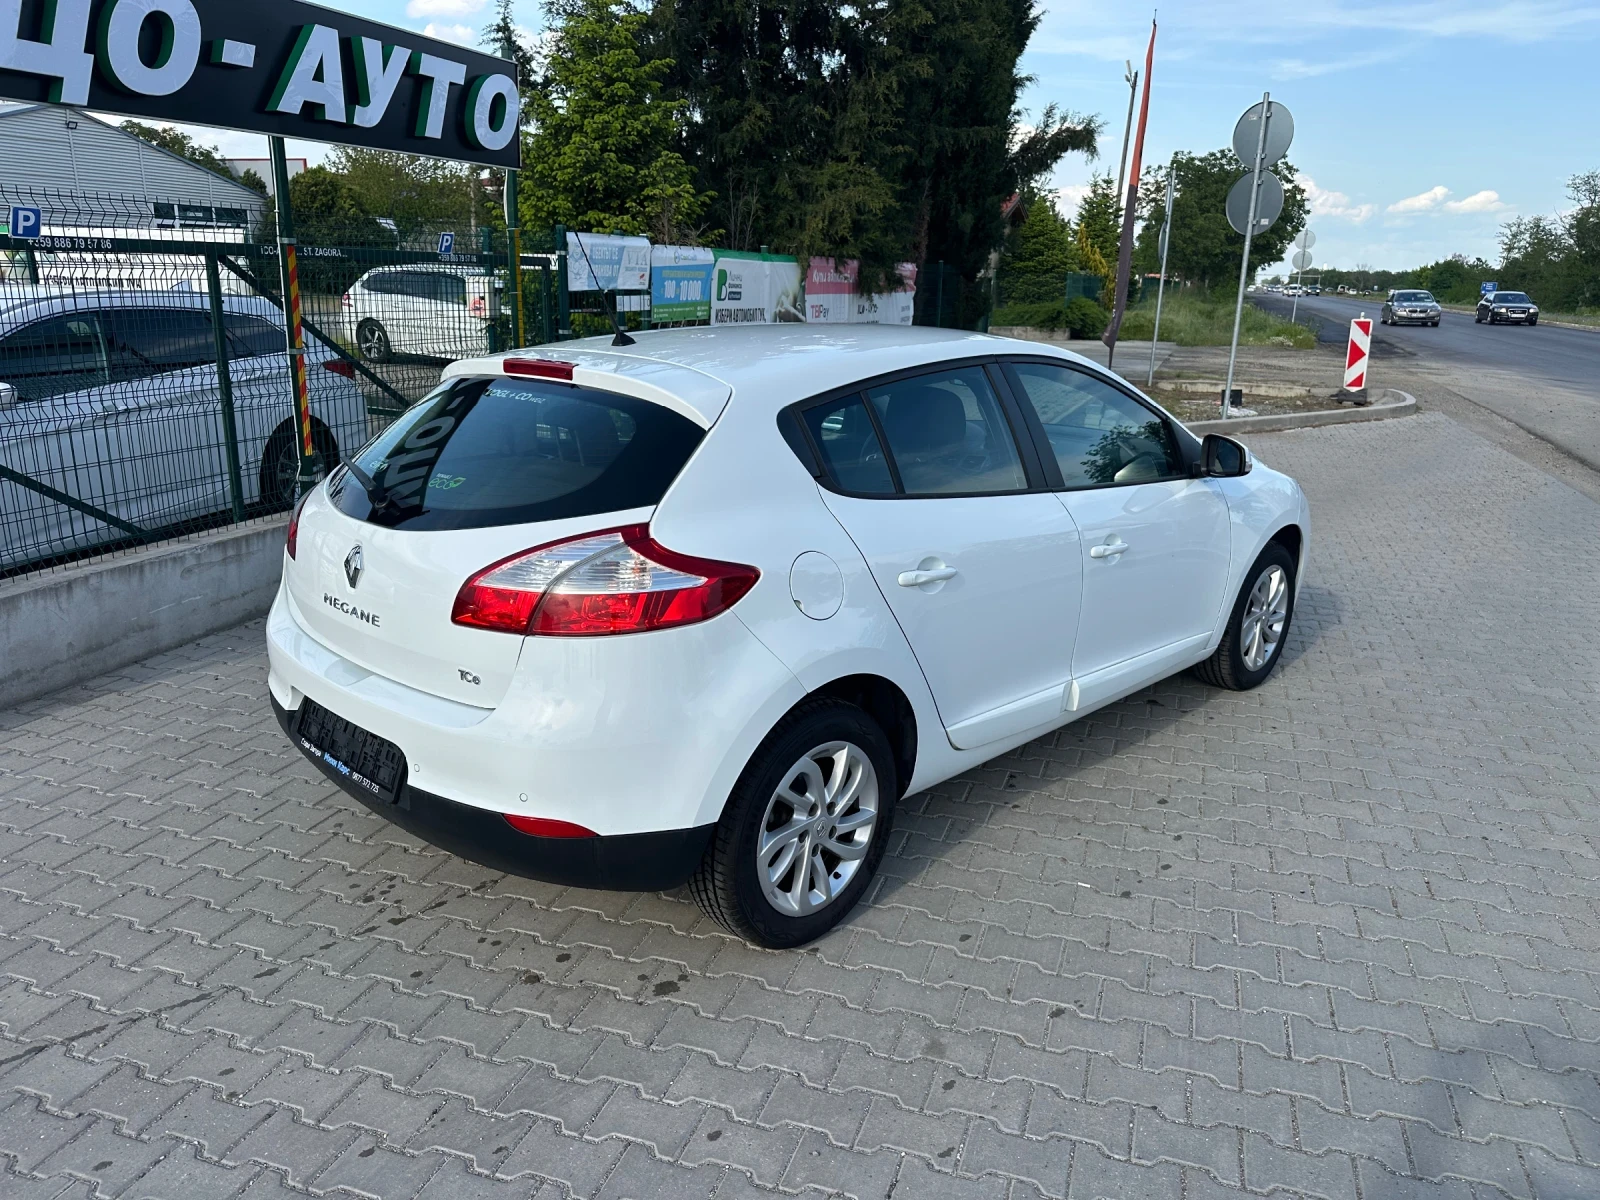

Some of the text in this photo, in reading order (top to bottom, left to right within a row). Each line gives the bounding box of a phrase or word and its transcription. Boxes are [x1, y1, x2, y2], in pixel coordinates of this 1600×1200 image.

[17, 210, 36, 235] P
[54, 237, 72, 248] 886
[73, 238, 85, 249] 79
[87, 238, 98, 249] 57
[441, 235, 452, 252] P
[664, 279, 676, 299] 100
[323, 592, 381, 628] MEGANE
[370, 781, 380, 793] 725
